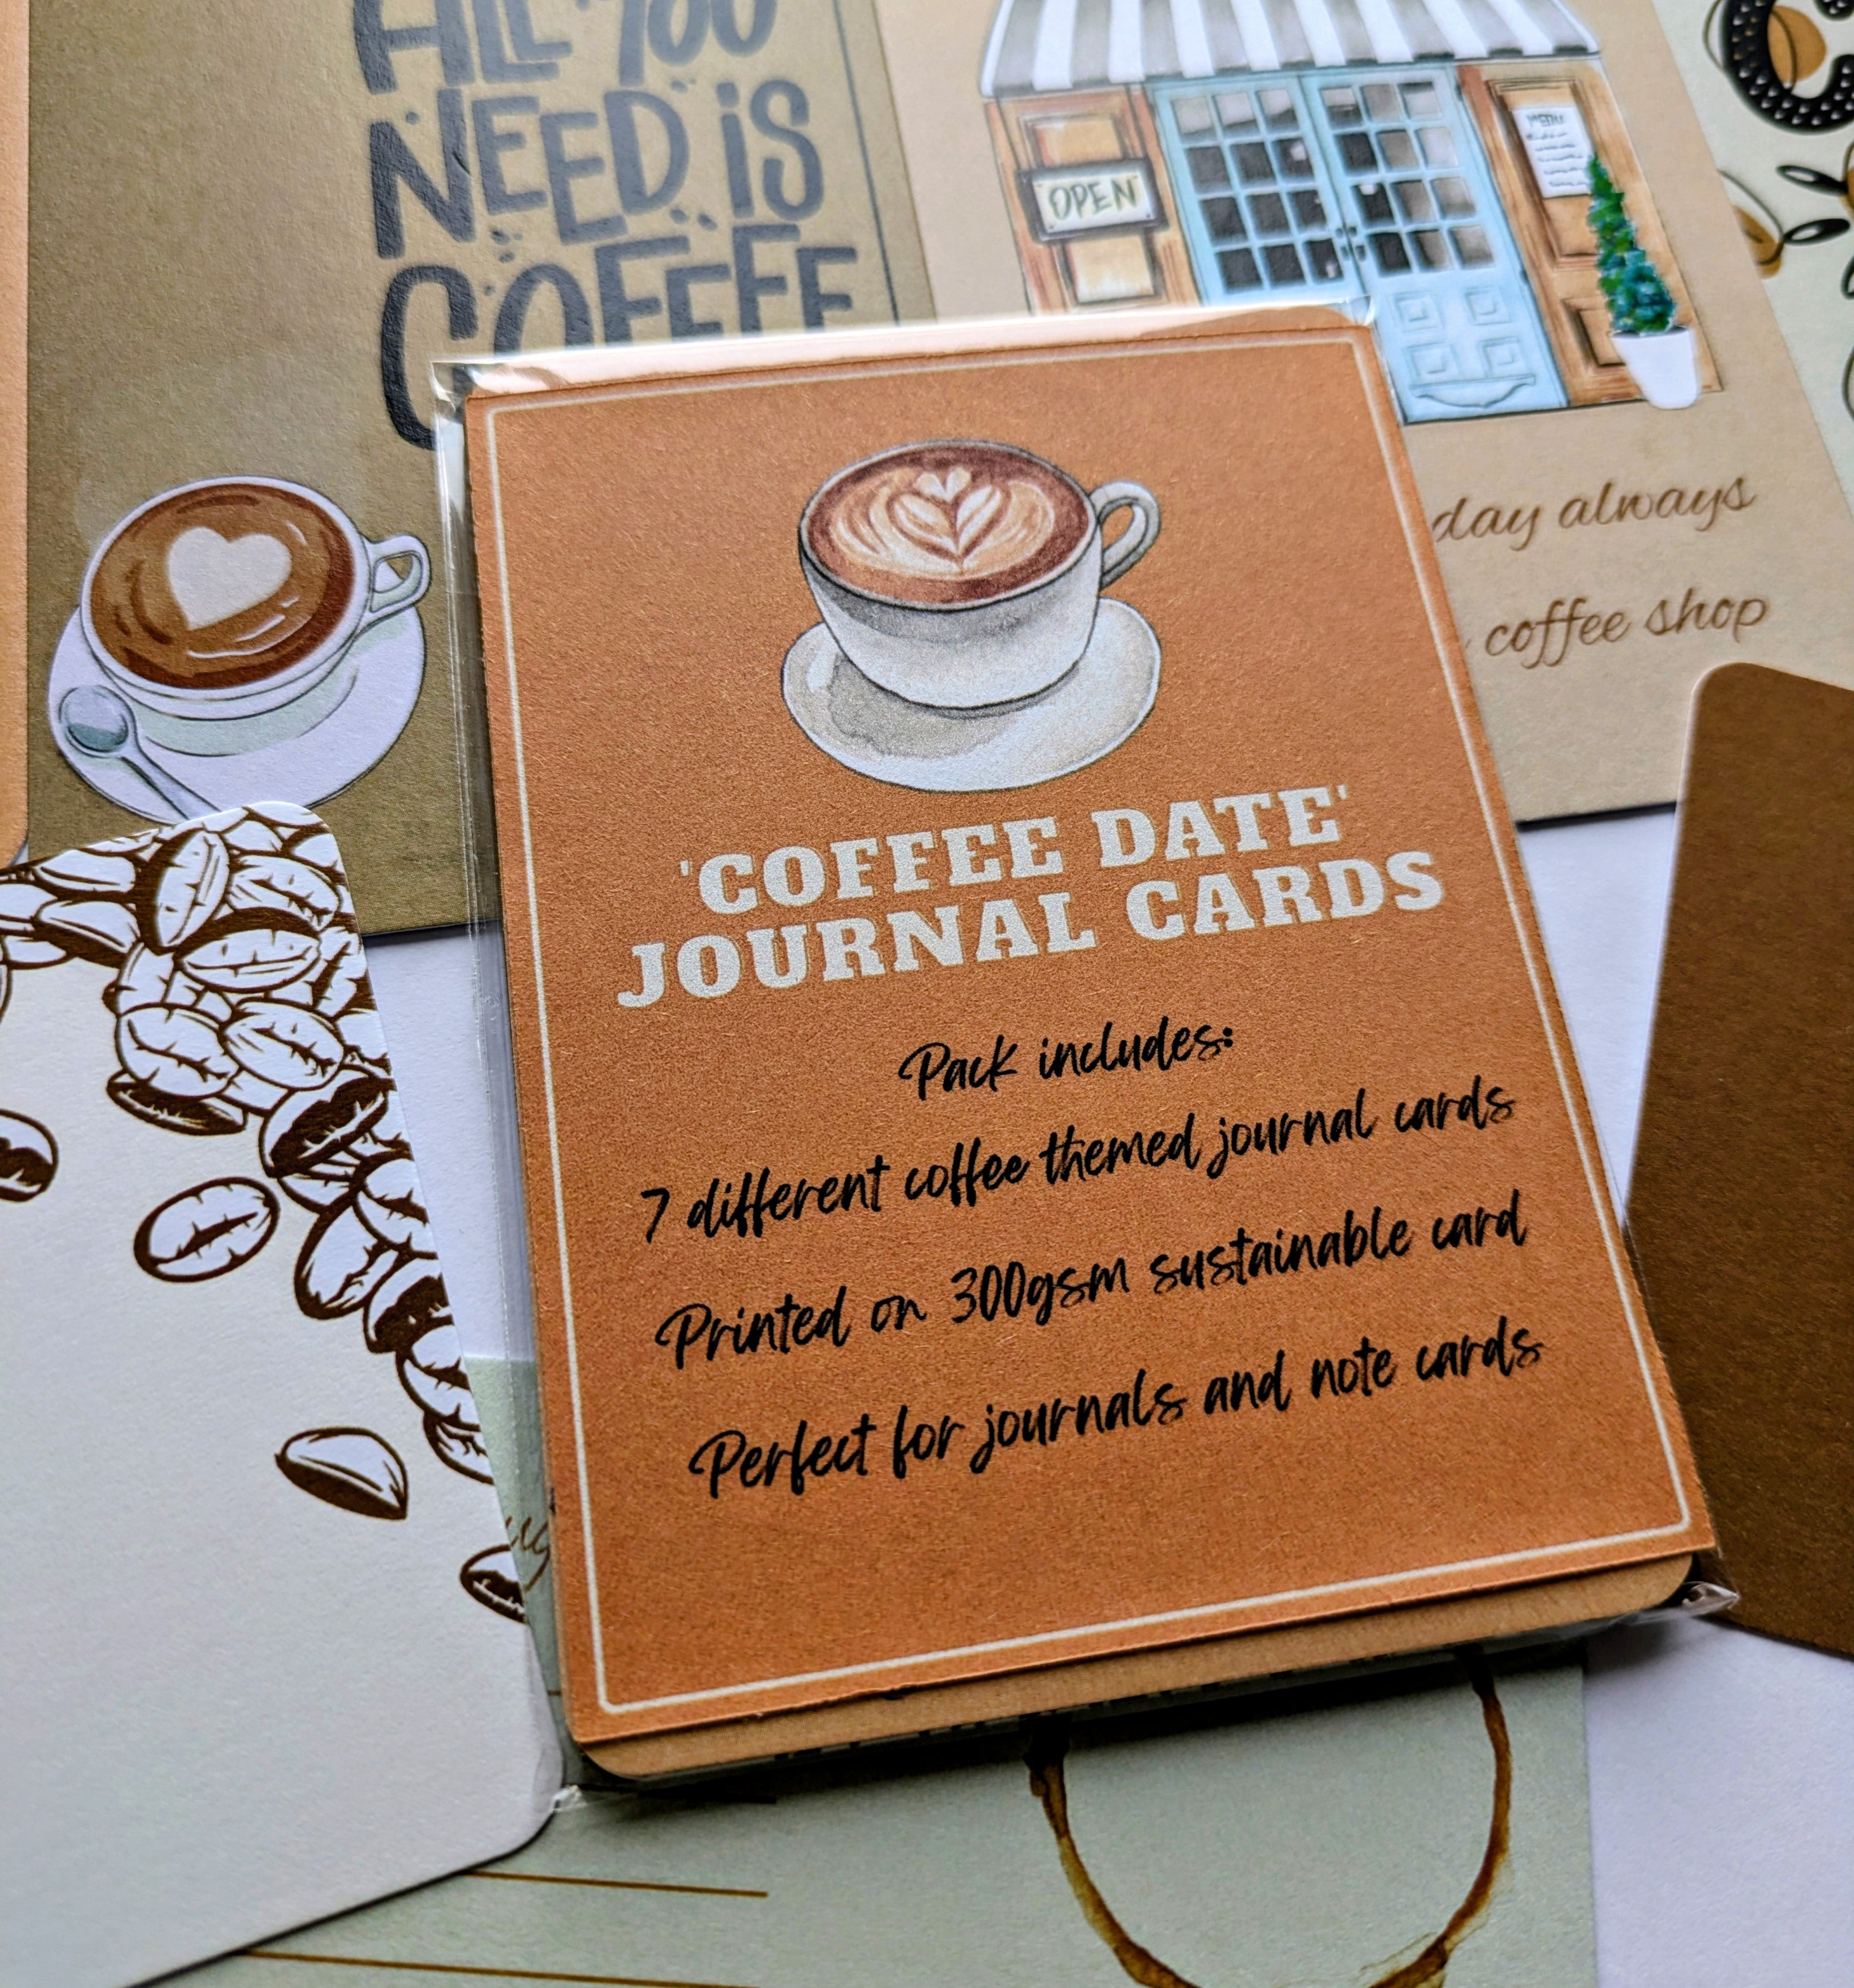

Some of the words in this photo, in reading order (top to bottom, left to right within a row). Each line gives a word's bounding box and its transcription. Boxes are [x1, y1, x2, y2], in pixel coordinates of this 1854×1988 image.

[352, 0, 572, 95] ALL
[367, 87, 690, 260] NEED
[1049, 178, 1137, 221] OPEN
[1432, 497, 1541, 551] day
[1558, 477, 1757, 532] always
[1484, 597, 1631, 670] coffee
[1645, 588, 1768, 643] shop
[679, 816, 1065, 915] 'COFFEE
[1090, 784, 1349, 868] DATE'
[618, 892, 1096, 1007] JOURNAL
[1127, 851, 1443, 940] CARDS
[898, 1035, 1017, 1101] Pack
[1040, 1016, 1233, 1079] includes:
[641, 1188, 670, 1243] 7
[687, 1155, 890, 1238] different
[905, 1137, 1030, 1207] coffee
[1039, 1113, 1201, 1185] themed
[1207, 1088, 1376, 1179] journal
[1395, 1075, 1515, 1132] cards
[655, 1286, 851, 1370] Printed
[871, 1295, 926, 1333] on
[951, 1258, 1129, 1326] 300gsm
[1150, 1207, 1411, 1294] sustainable
[1432, 1189, 1527, 1250] card
[688, 1414, 876, 1499] Perfect
[893, 1405, 965, 1479] for
[970, 1369, 1187, 1474] journals
[1204, 1350, 1292, 1415] and
[1311, 1337, 1397, 1398] note
[1416, 1316, 1543, 1380] cards
